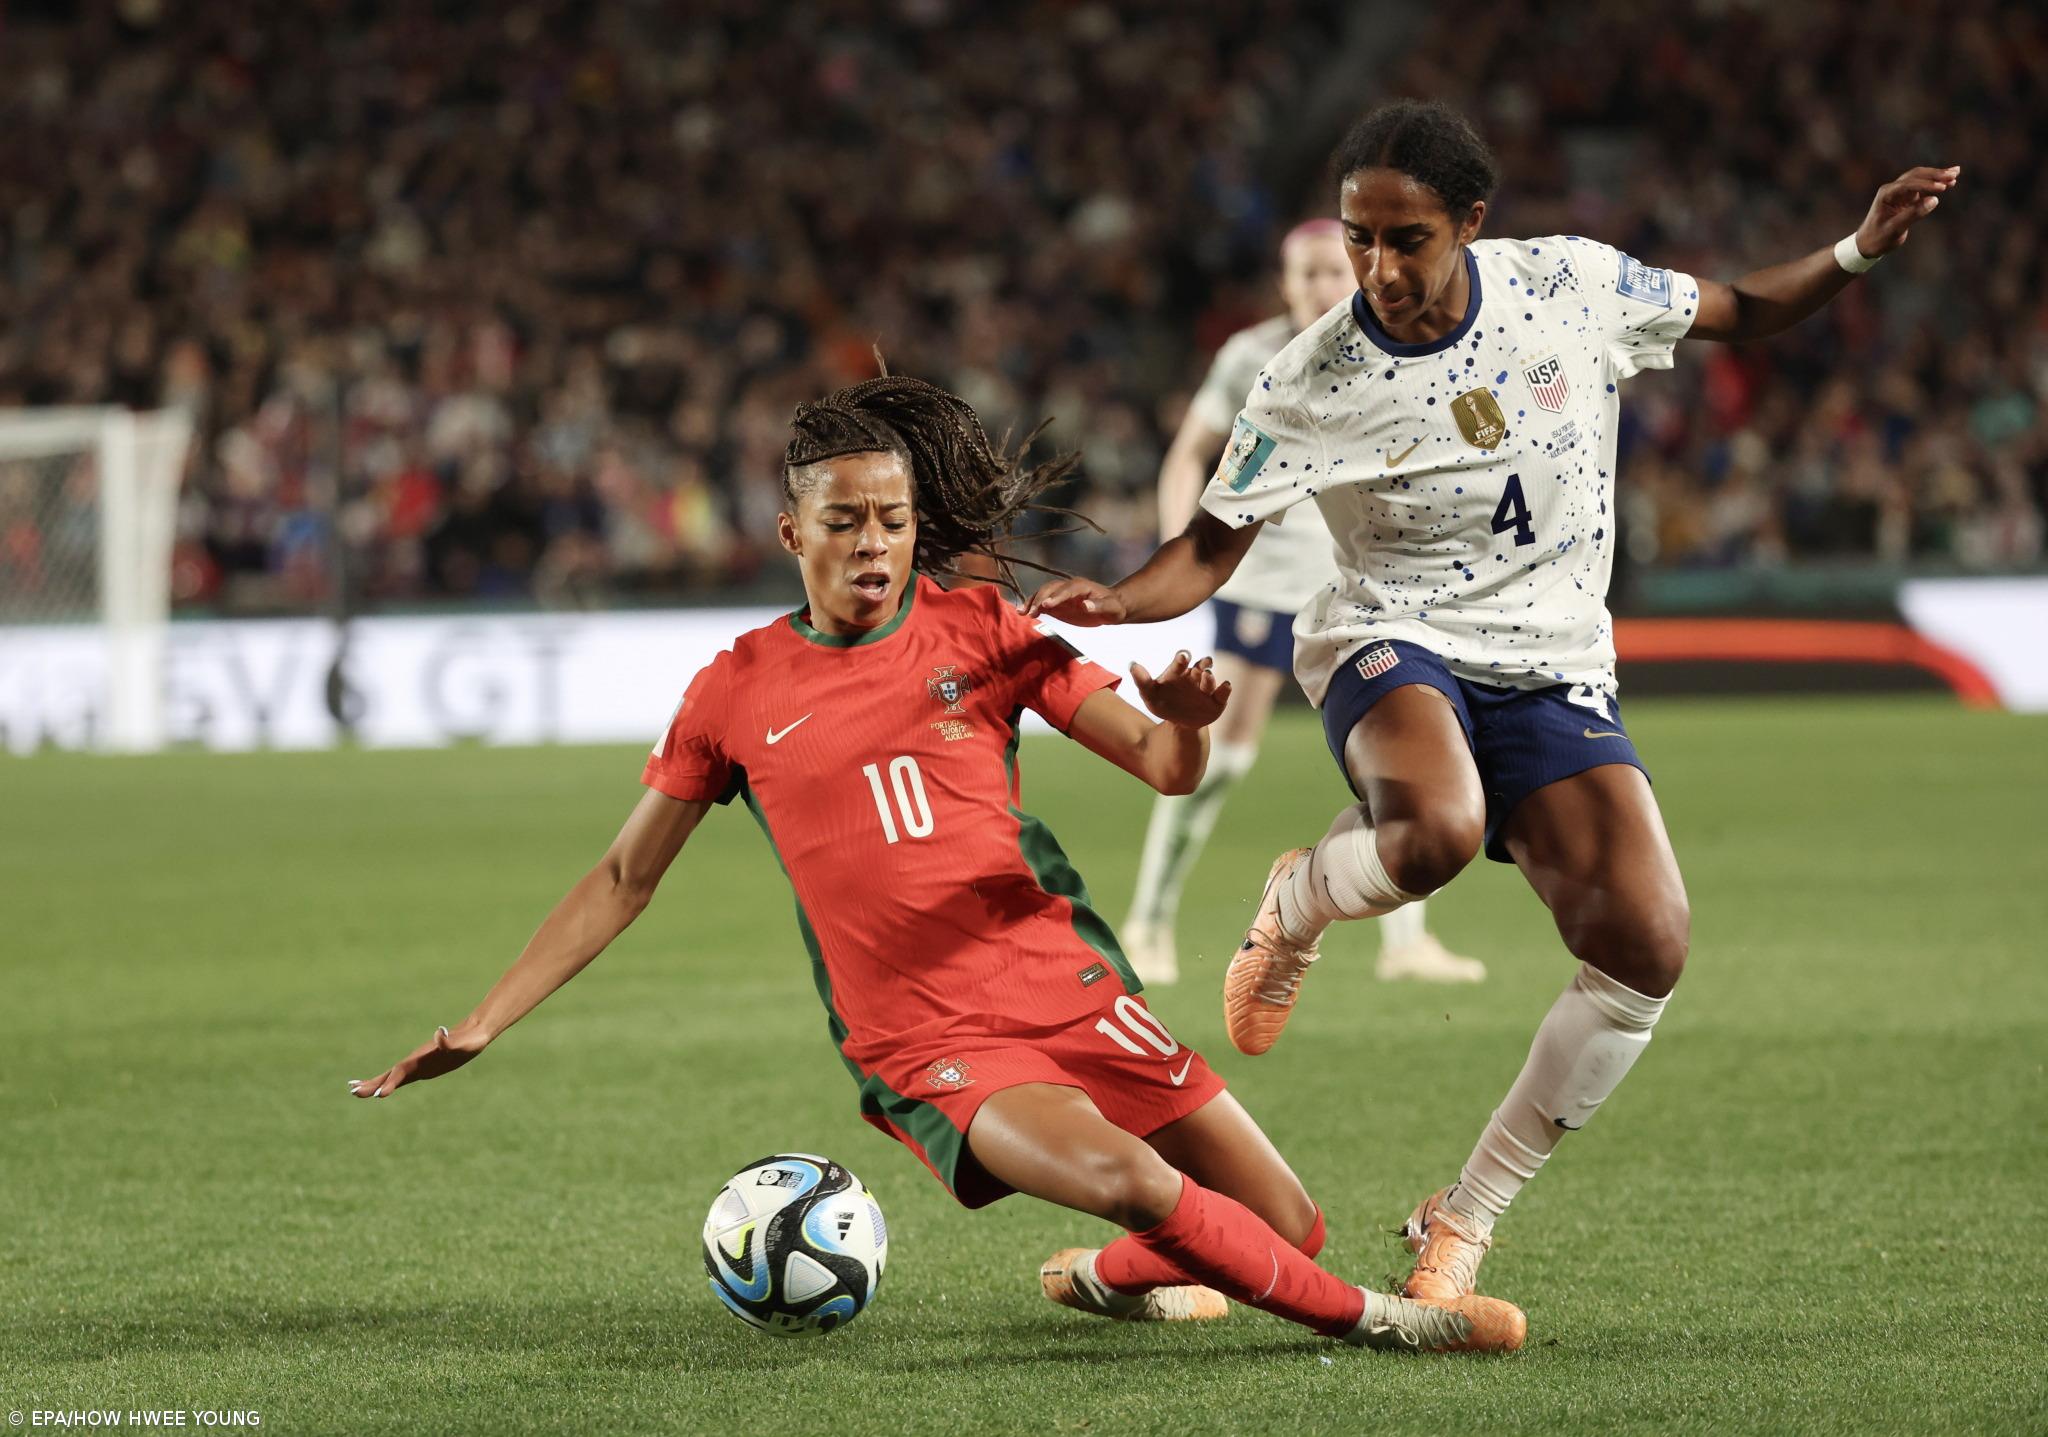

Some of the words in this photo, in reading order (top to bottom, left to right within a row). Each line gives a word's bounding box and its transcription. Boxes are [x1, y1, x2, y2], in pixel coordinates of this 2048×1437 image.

[1528, 359, 1559, 384] USA
[1475, 425, 1497, 440] FIFA
[1491, 473, 1536, 547] 4
[1359, 648, 1391, 668] USA
[862, 755, 934, 845] 10
[1094, 995, 1179, 1061] 10
